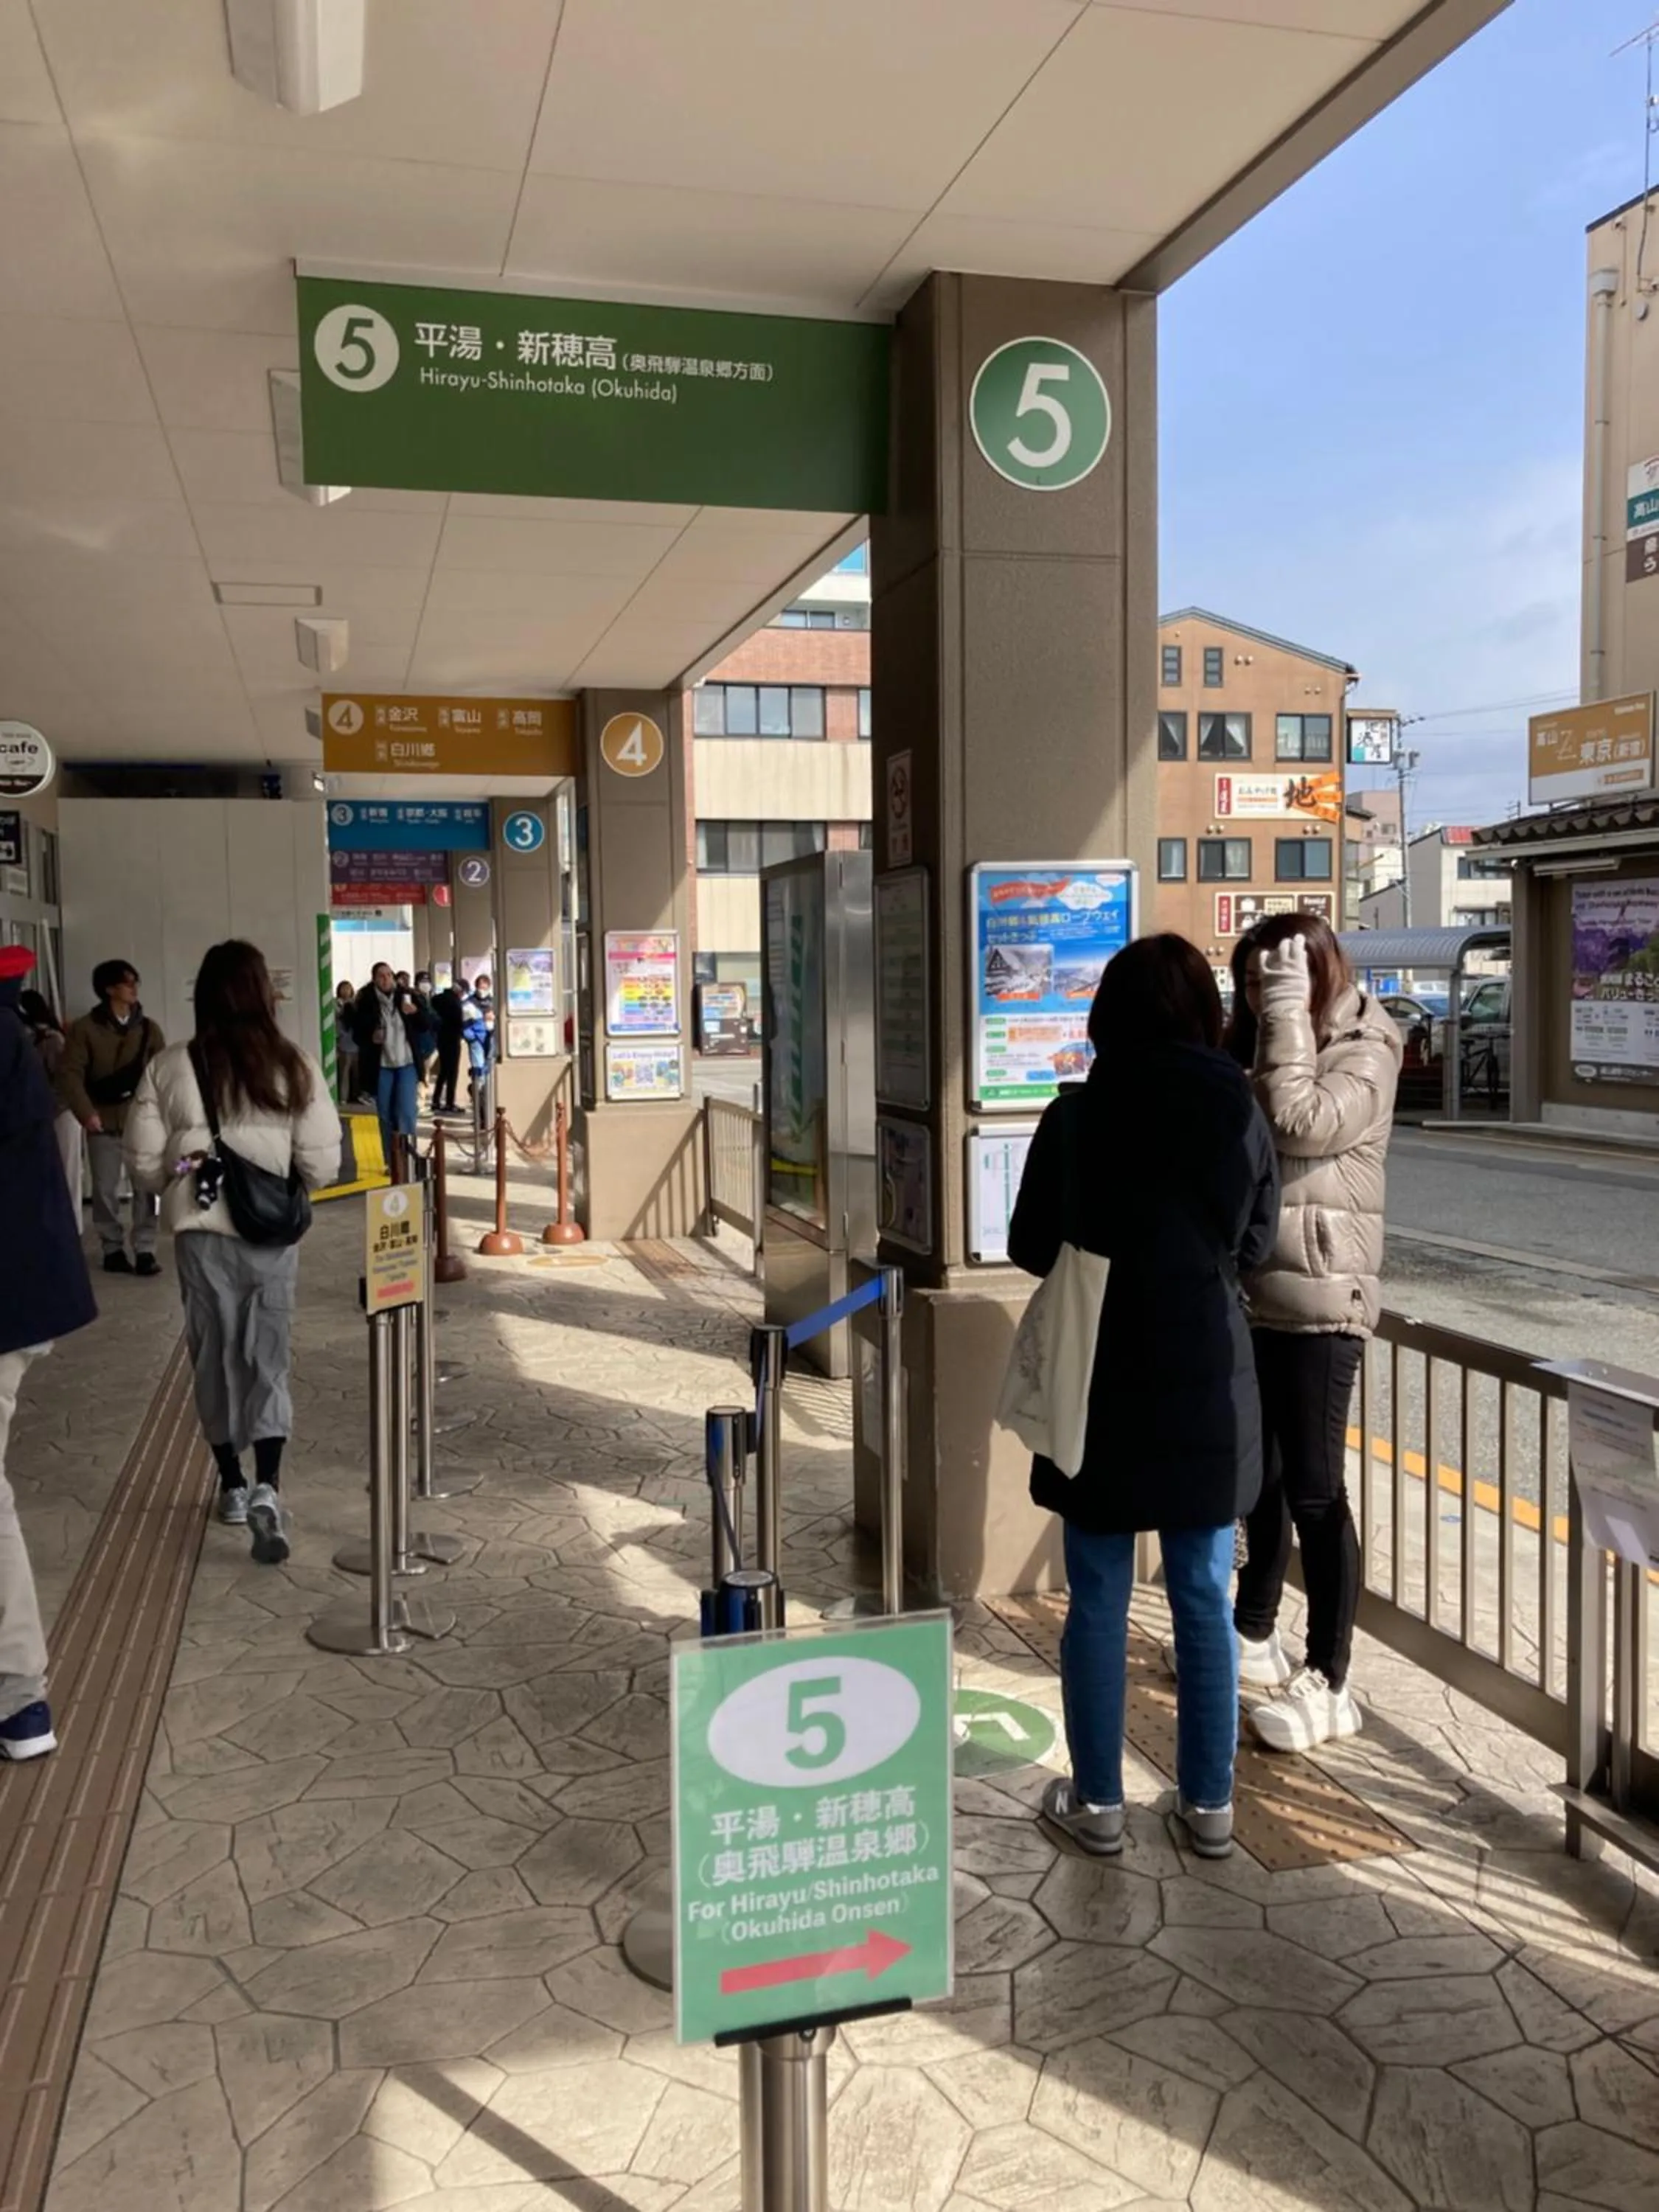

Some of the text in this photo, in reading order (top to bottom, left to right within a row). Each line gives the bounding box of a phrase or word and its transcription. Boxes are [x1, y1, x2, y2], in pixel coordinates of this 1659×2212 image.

[334, 317, 376, 379] 5
[414, 321, 617, 370] 平湯・新穂高
[420, 367, 678, 403] Hirayu-Shinhotaka (Okuhida)
[1006, 362, 1072, 467] 5
[335, 705, 353, 729] 4
[0, 742, 38, 754] cafe
[616, 721, 647, 768] 4
[516, 817, 534, 847] 3
[467, 861, 481, 882] 2
[785, 1675, 847, 1770] 5
[710, 1785, 916, 1846] 平湯・新穂高
[688, 1865, 939, 1922] For Hirayu/Shinhotaka
